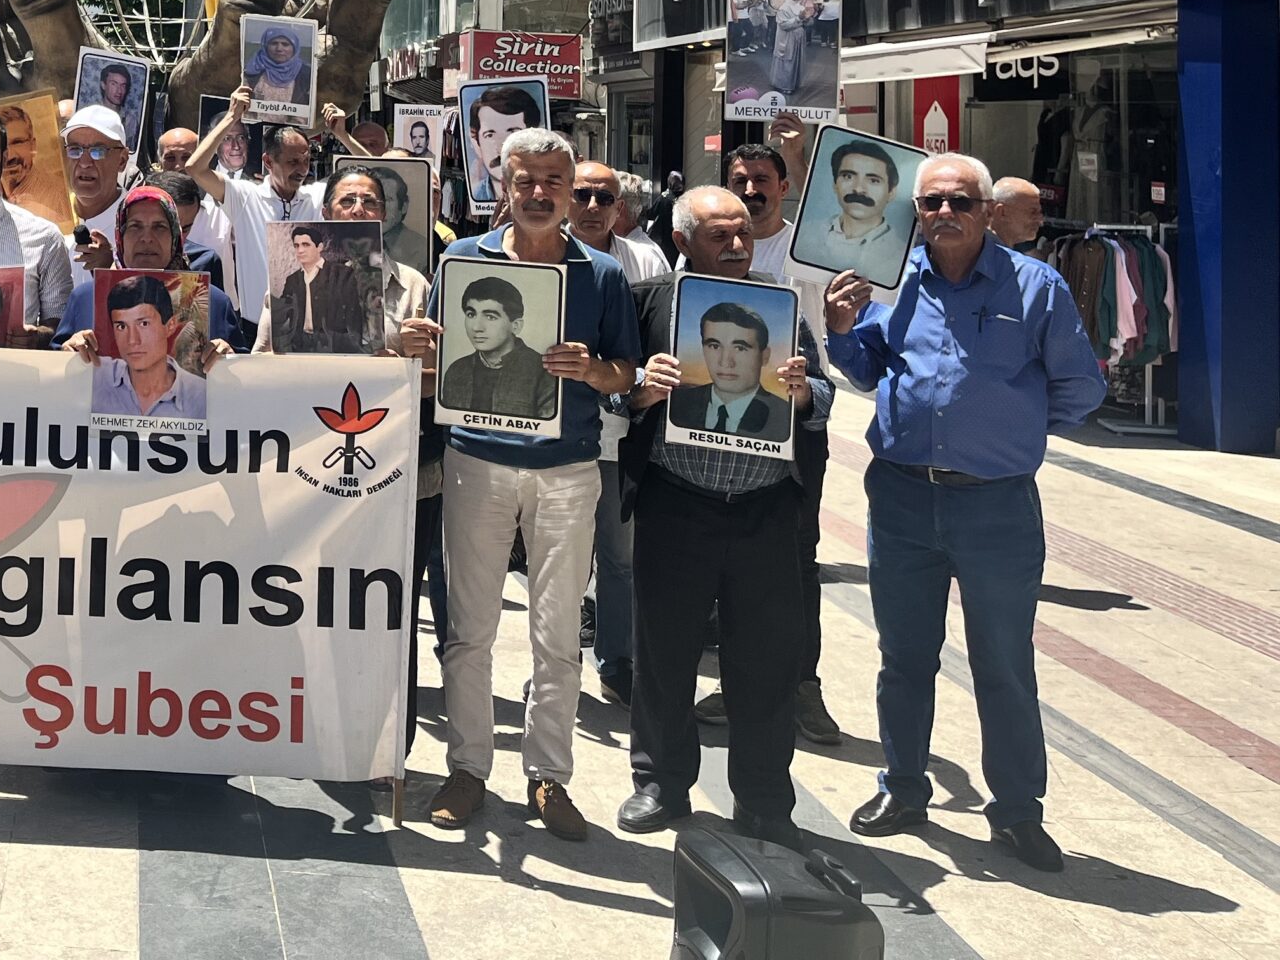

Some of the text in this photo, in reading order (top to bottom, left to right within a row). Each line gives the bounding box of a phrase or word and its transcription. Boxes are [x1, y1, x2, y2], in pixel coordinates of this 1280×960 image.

[493, 36, 560, 59] Şirin
[479, 57, 575, 75] Collection
[281, 104, 298, 113] Ana
[92, 417, 205, 431] MEHMET ZEKİ AKYILDIZ
[463, 413, 541, 431] ÇETİN ABAY
[688, 431, 782, 454] RESUL SAÇAN
[294, 466, 404, 499] İNSAN HAKLARI DERNEĞİ
[337, 476, 360, 488] 1986
[21, 663, 306, 750] Şubesi
